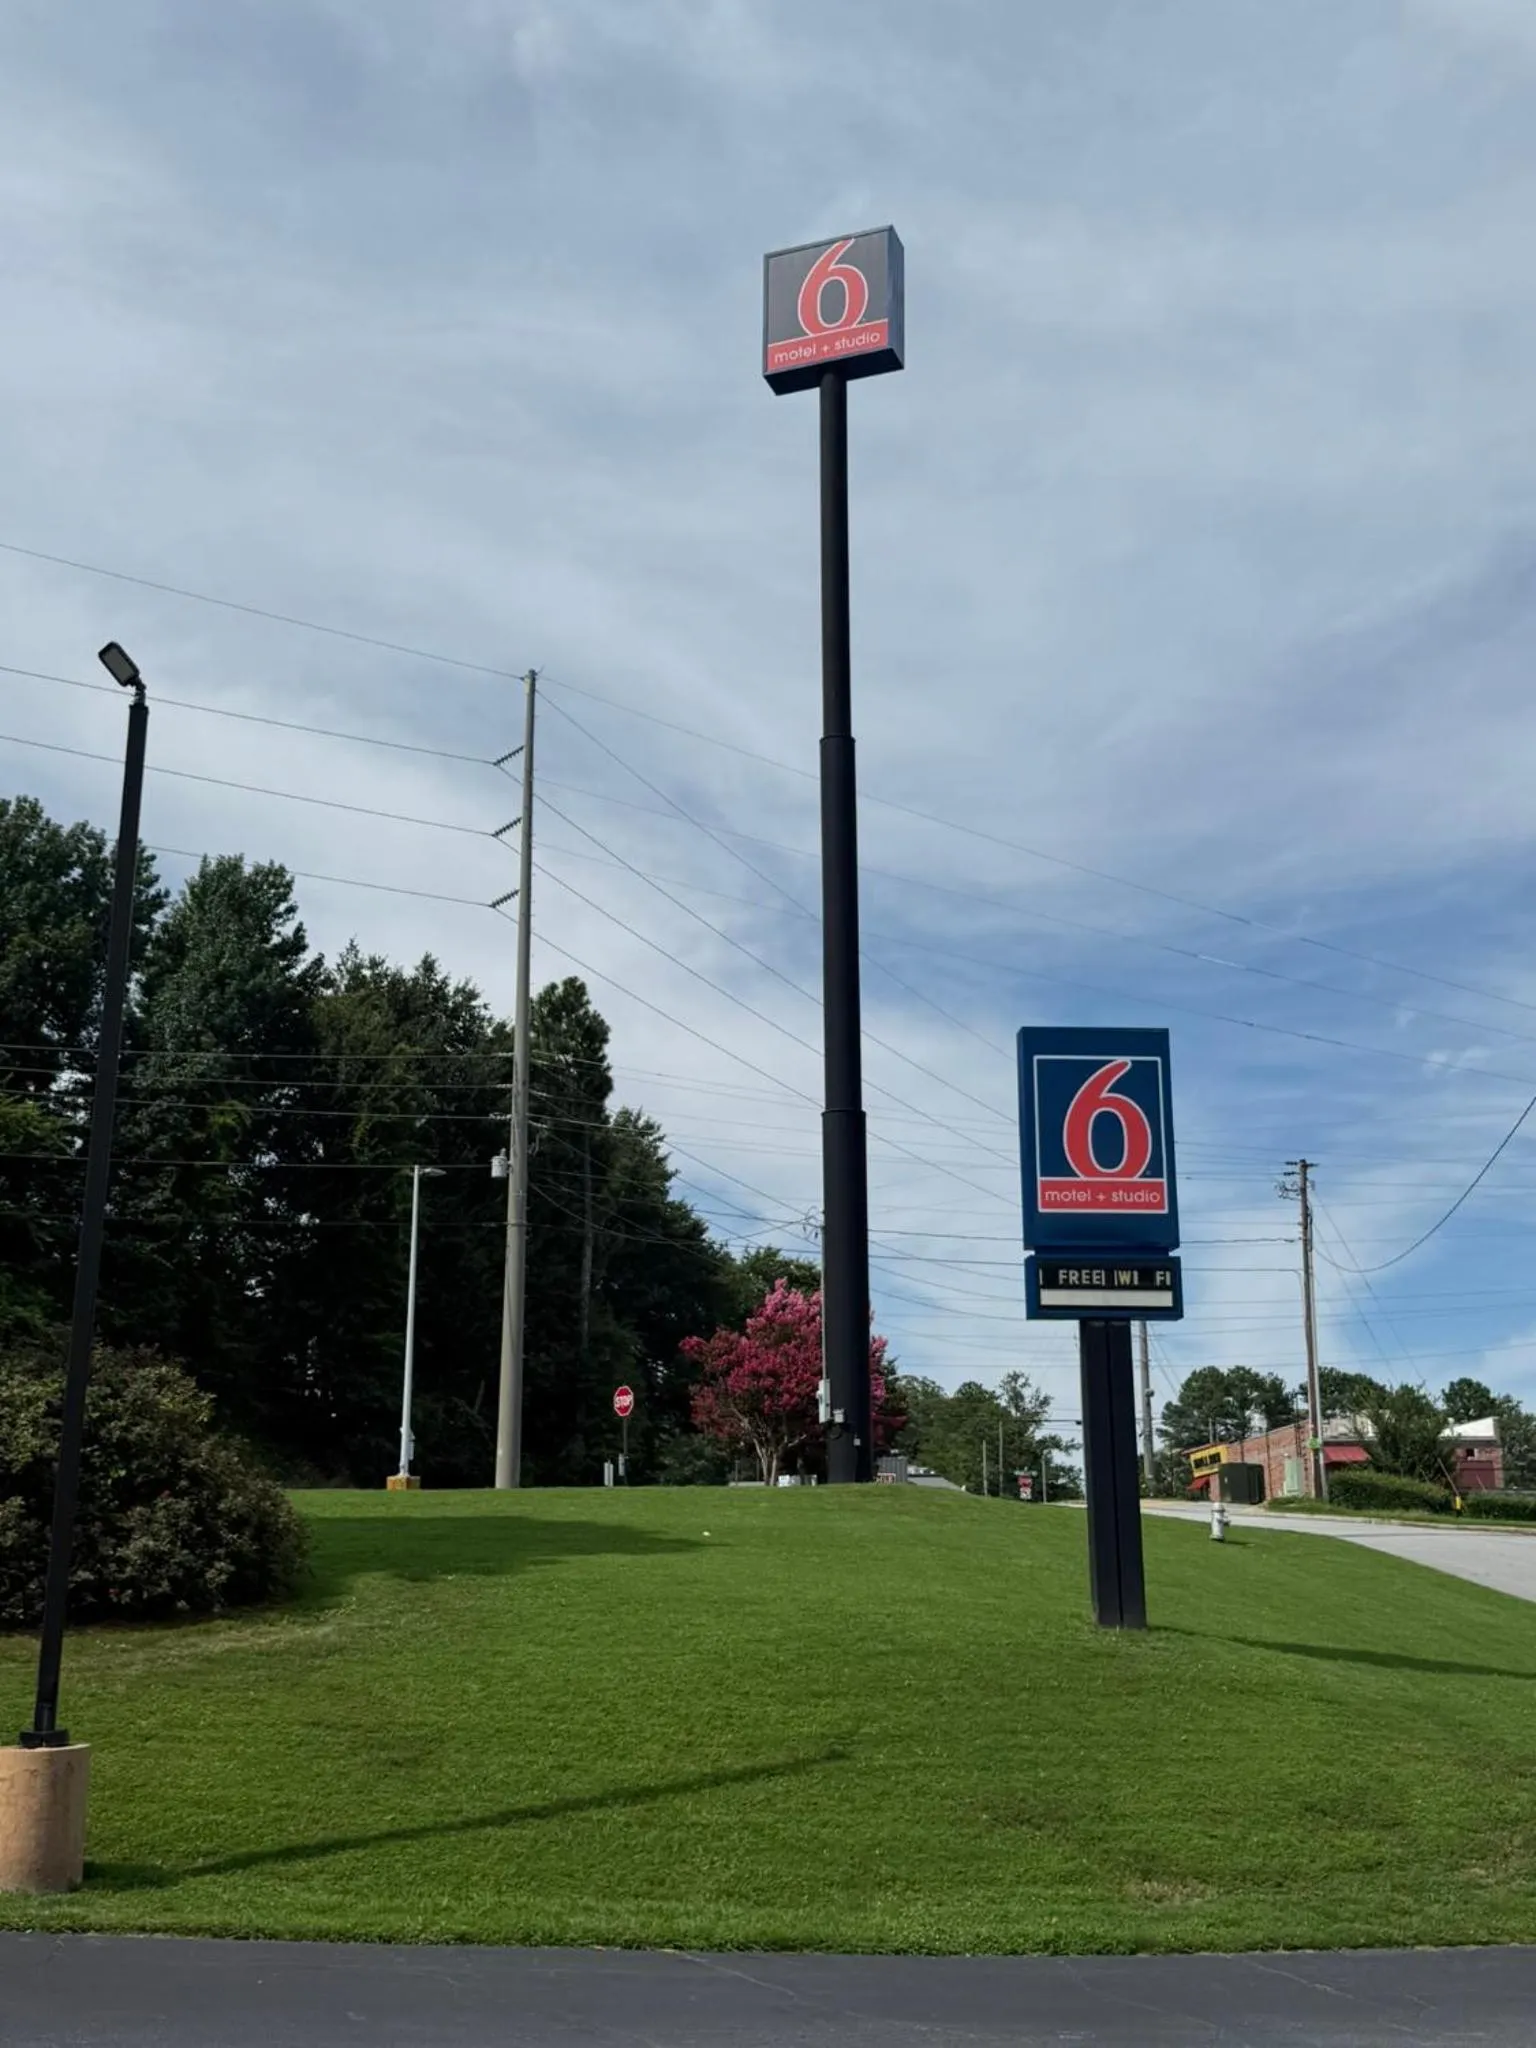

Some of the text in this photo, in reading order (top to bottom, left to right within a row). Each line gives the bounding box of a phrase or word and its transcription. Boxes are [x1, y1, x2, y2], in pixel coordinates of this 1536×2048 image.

[798, 238, 869, 336] 6
[774, 344, 816, 364] motel
[834, 332, 880, 350] studio
[1063, 1059, 1152, 1180] 6
[1044, 1189, 1091, 1203] motel
[1112, 1189, 1160, 1203] studio
[615, 1395, 632, 1407] STOP
